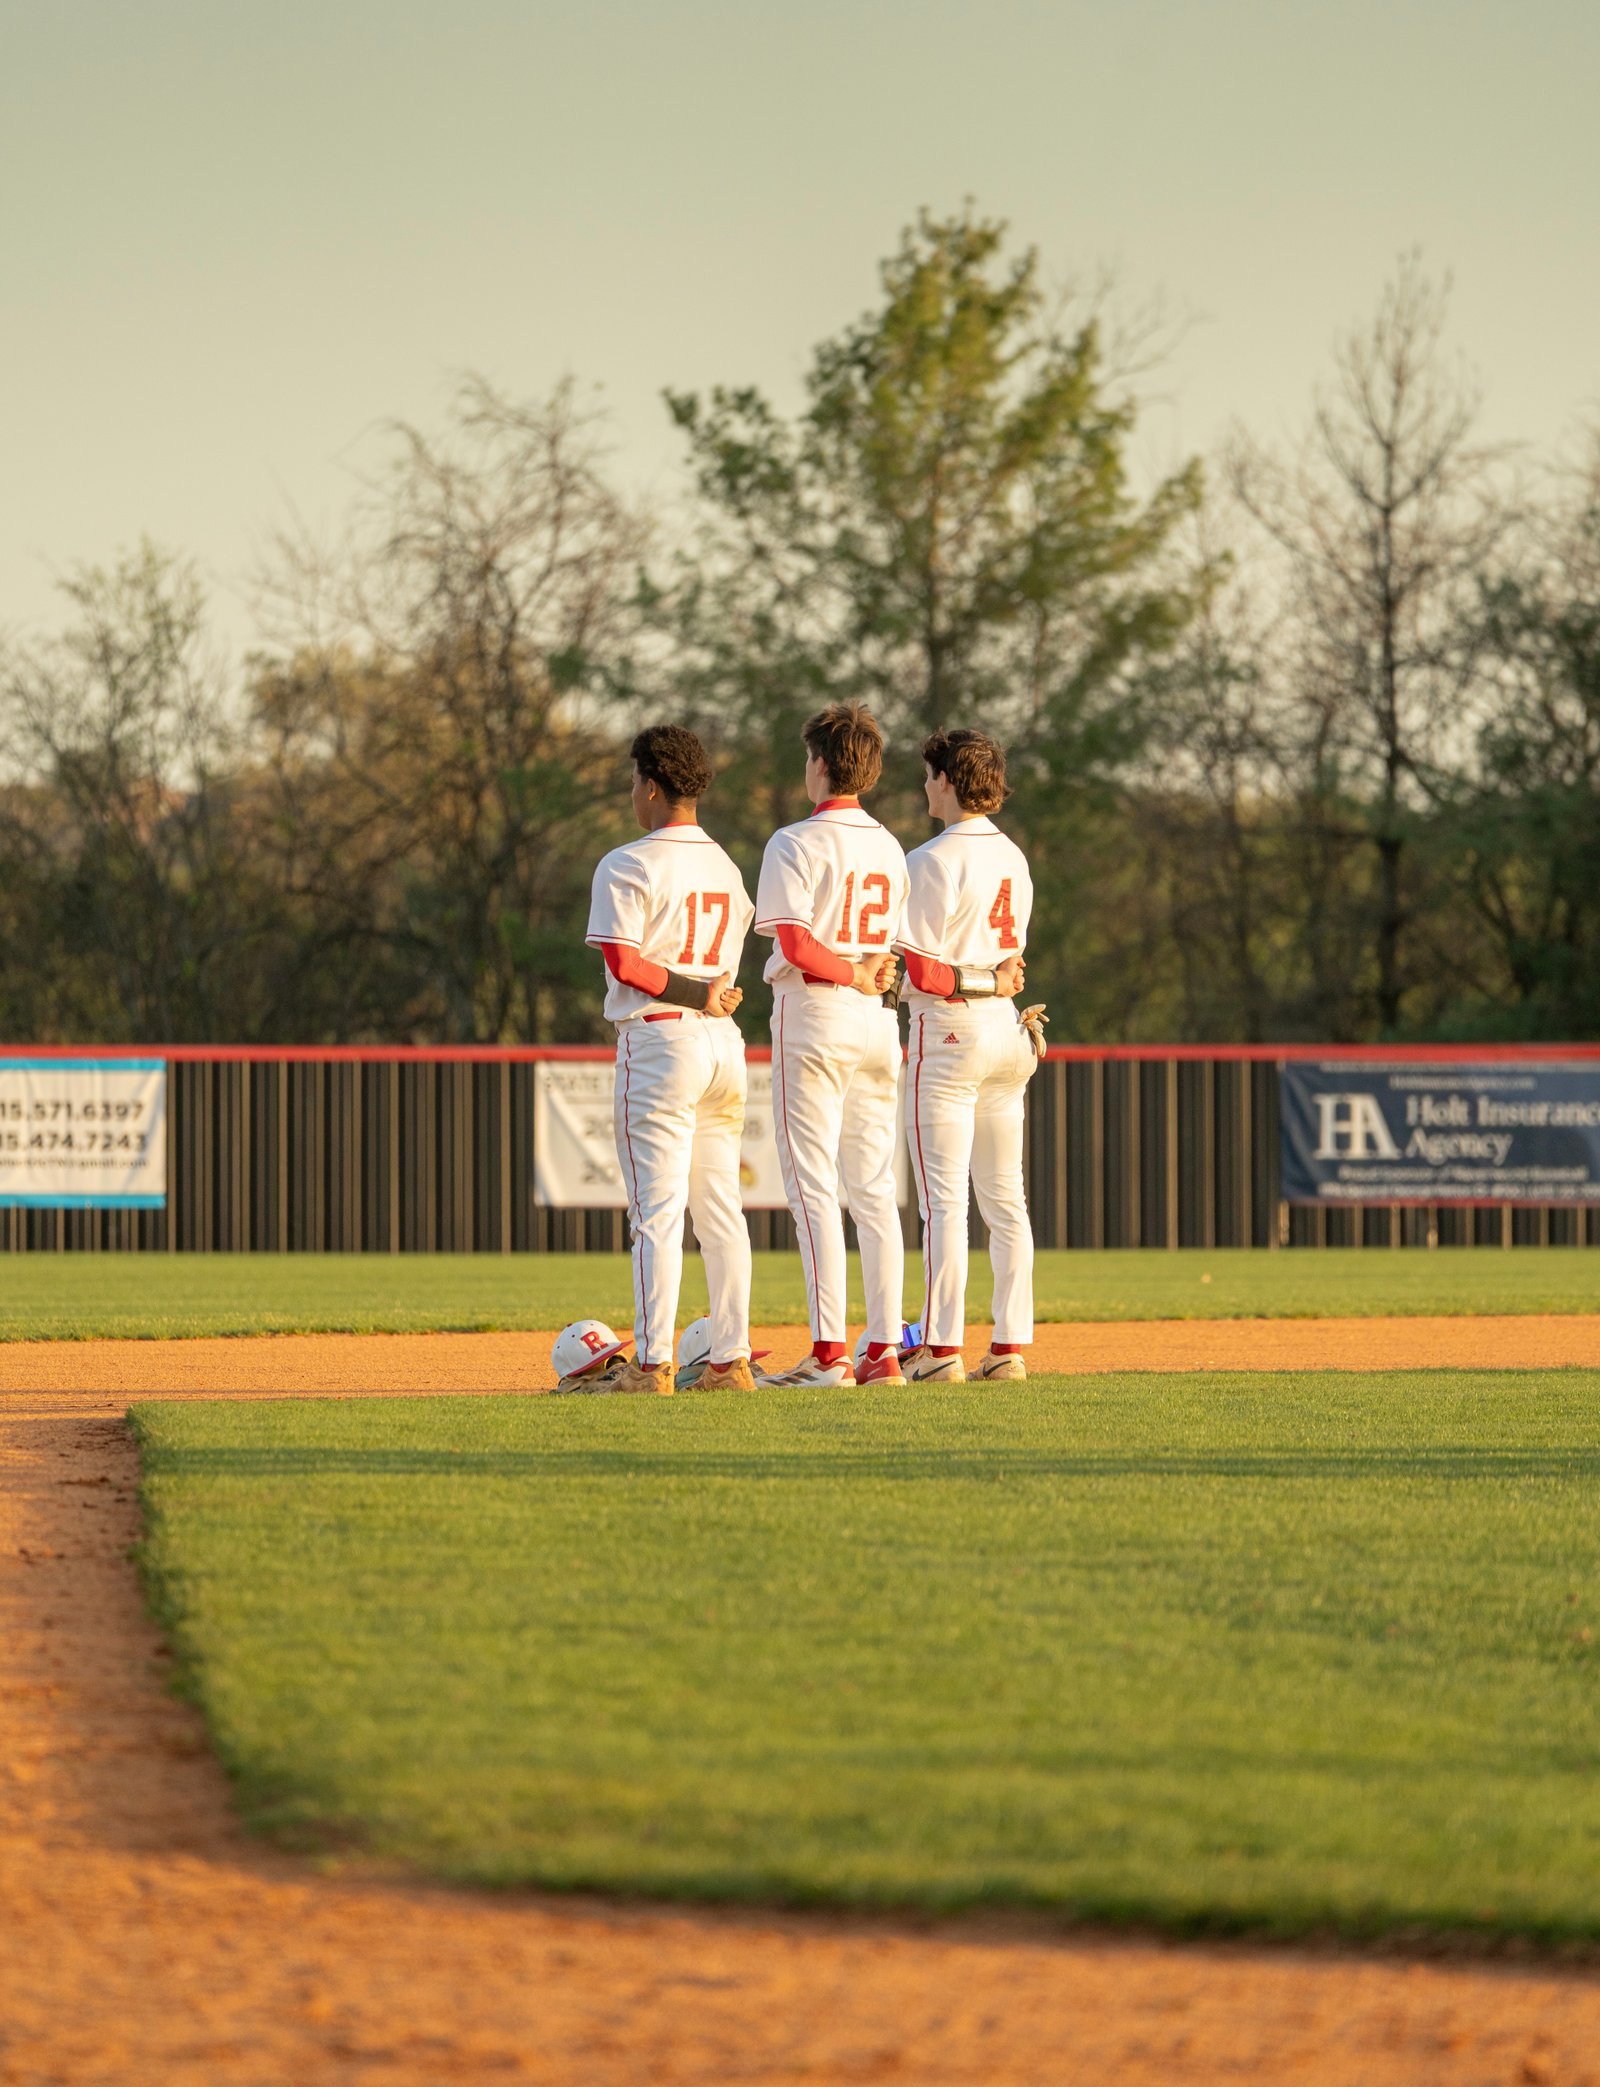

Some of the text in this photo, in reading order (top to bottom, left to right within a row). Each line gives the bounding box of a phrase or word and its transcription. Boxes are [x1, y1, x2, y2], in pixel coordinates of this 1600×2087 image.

[677, 891, 730, 965] 17
[835, 871, 891, 945] 12
[988, 878, 1018, 949] 4
[1312, 1092, 1401, 1161] HA
[1405, 1094, 1470, 1128] Holt
[1405, 1128, 1513, 1166] Agency
[580, 1331, 609, 1355] R
